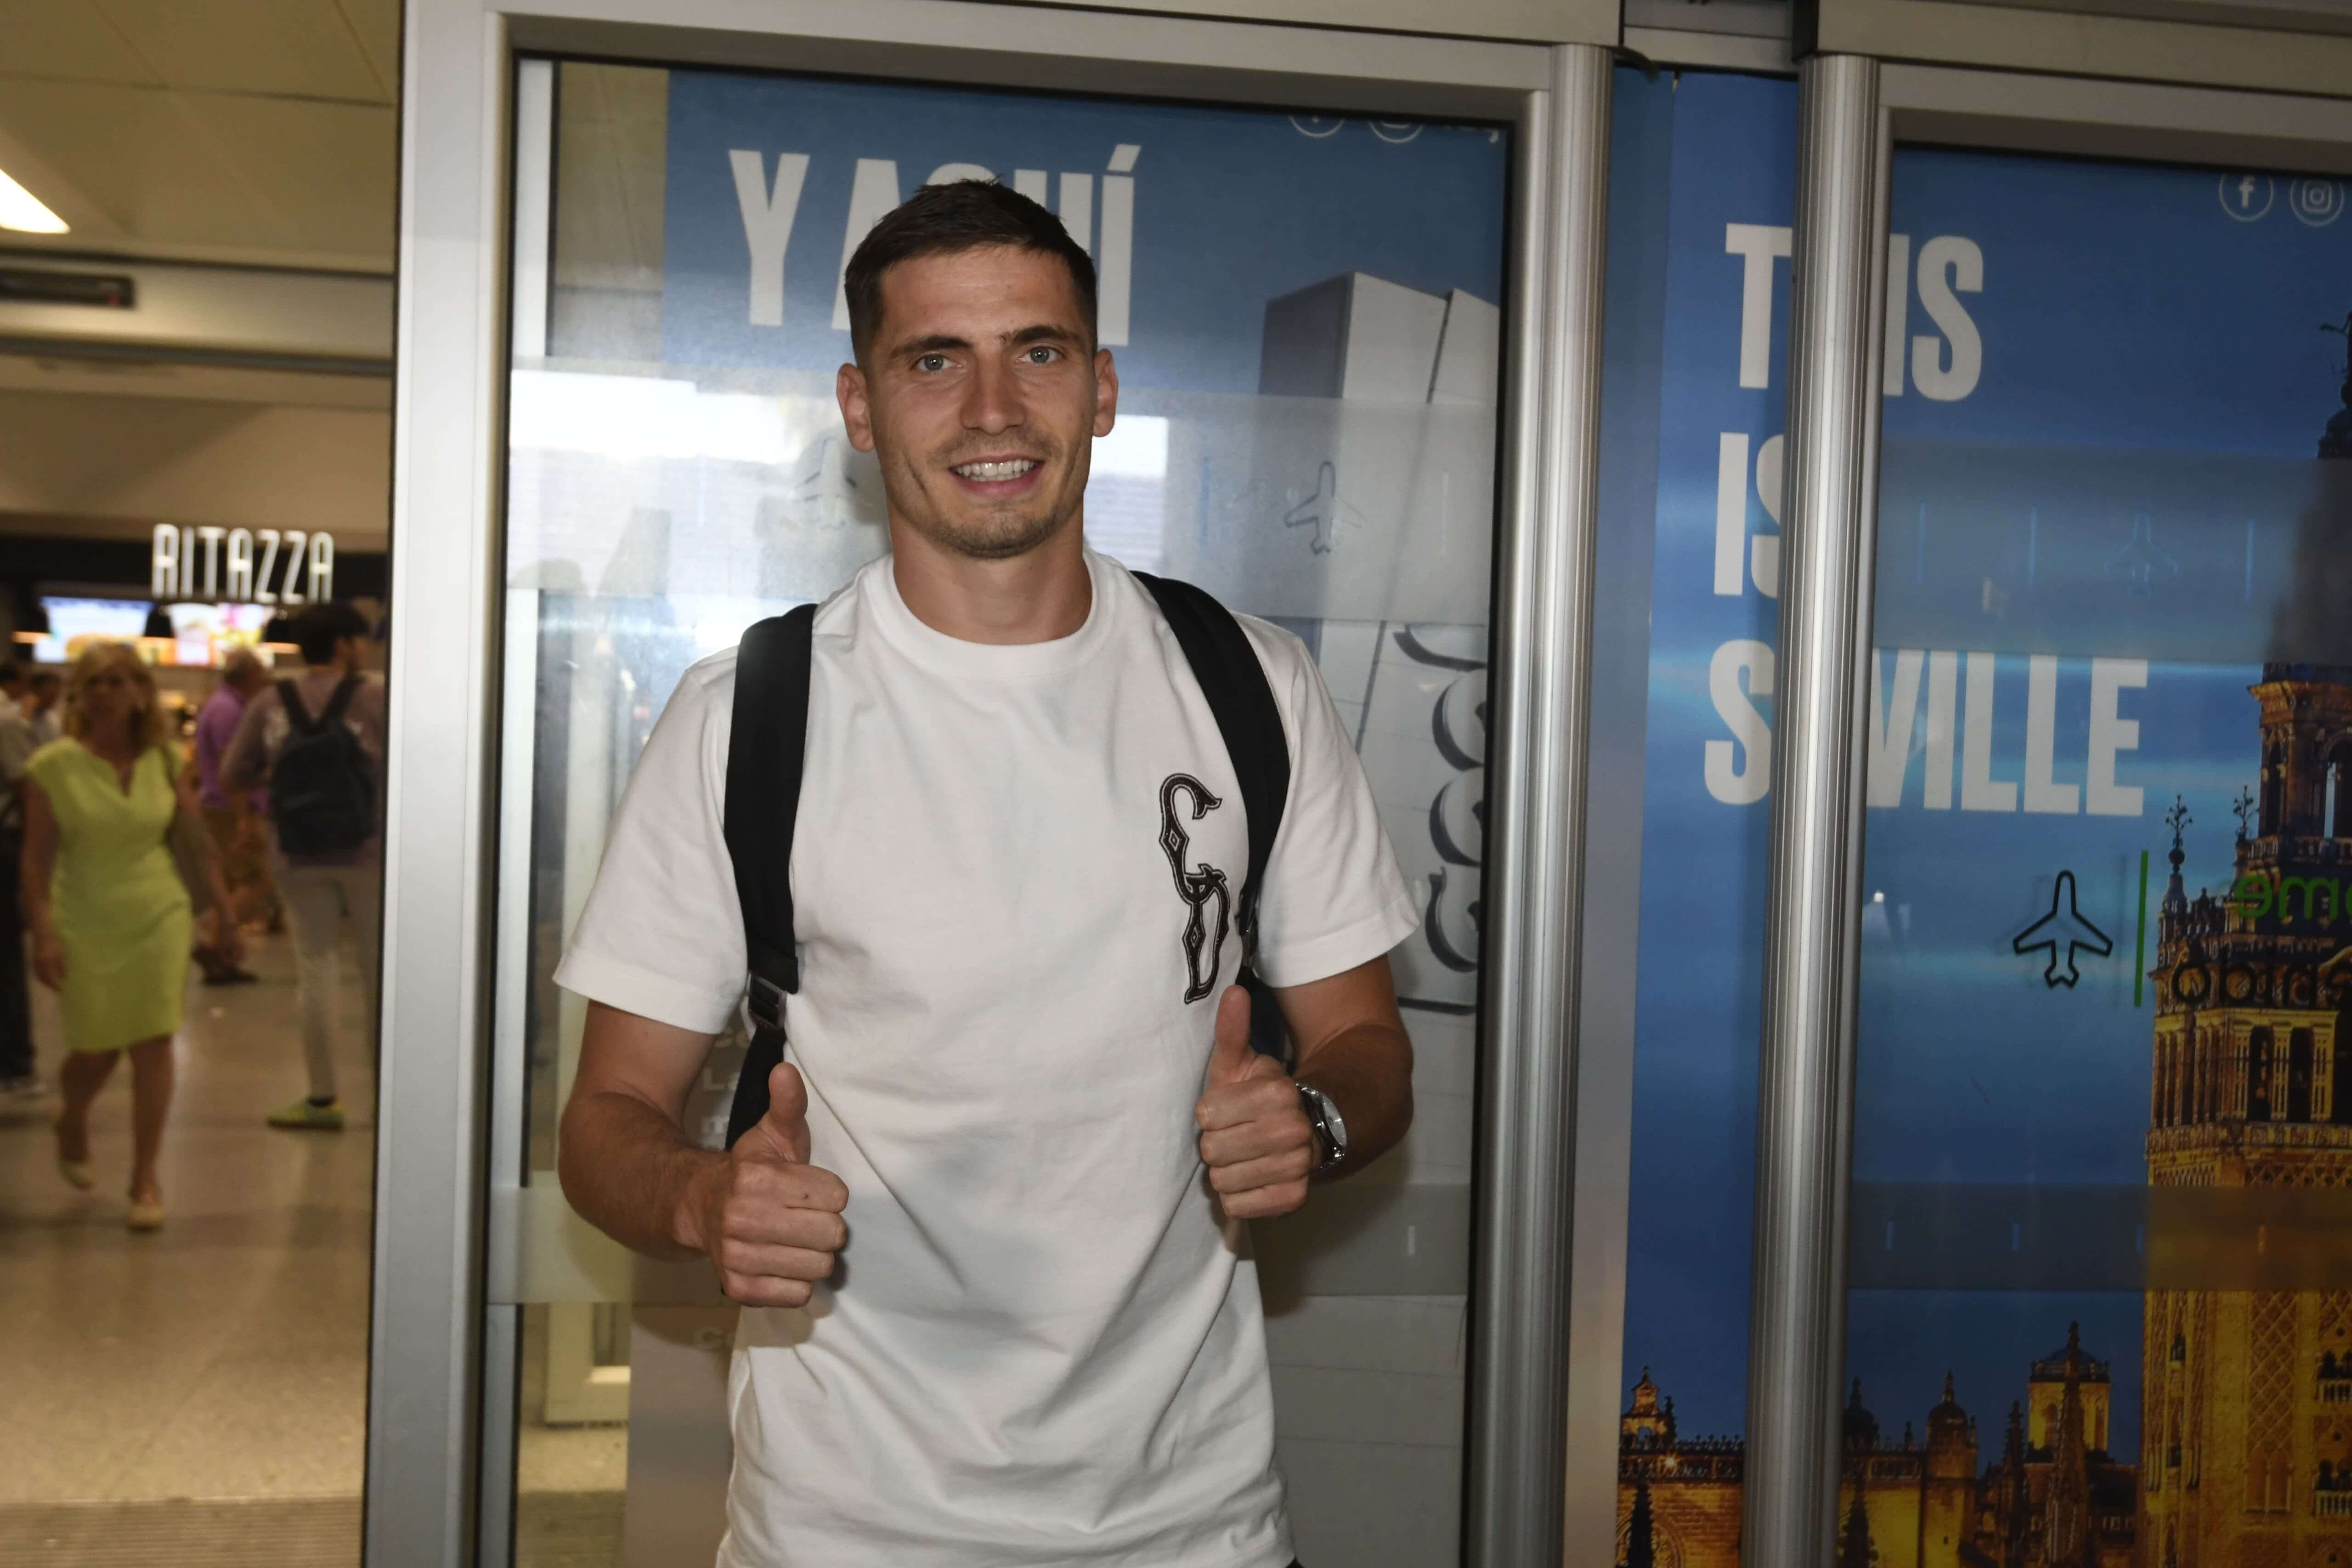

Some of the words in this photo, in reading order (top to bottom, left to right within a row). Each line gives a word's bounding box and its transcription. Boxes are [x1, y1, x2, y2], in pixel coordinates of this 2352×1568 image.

[729, 149, 810, 327] Y
[1725, 222, 1984, 402] TIS
[152, 523, 334, 604] RITAZZA
[1704, 639, 2148, 816] SVILLE
